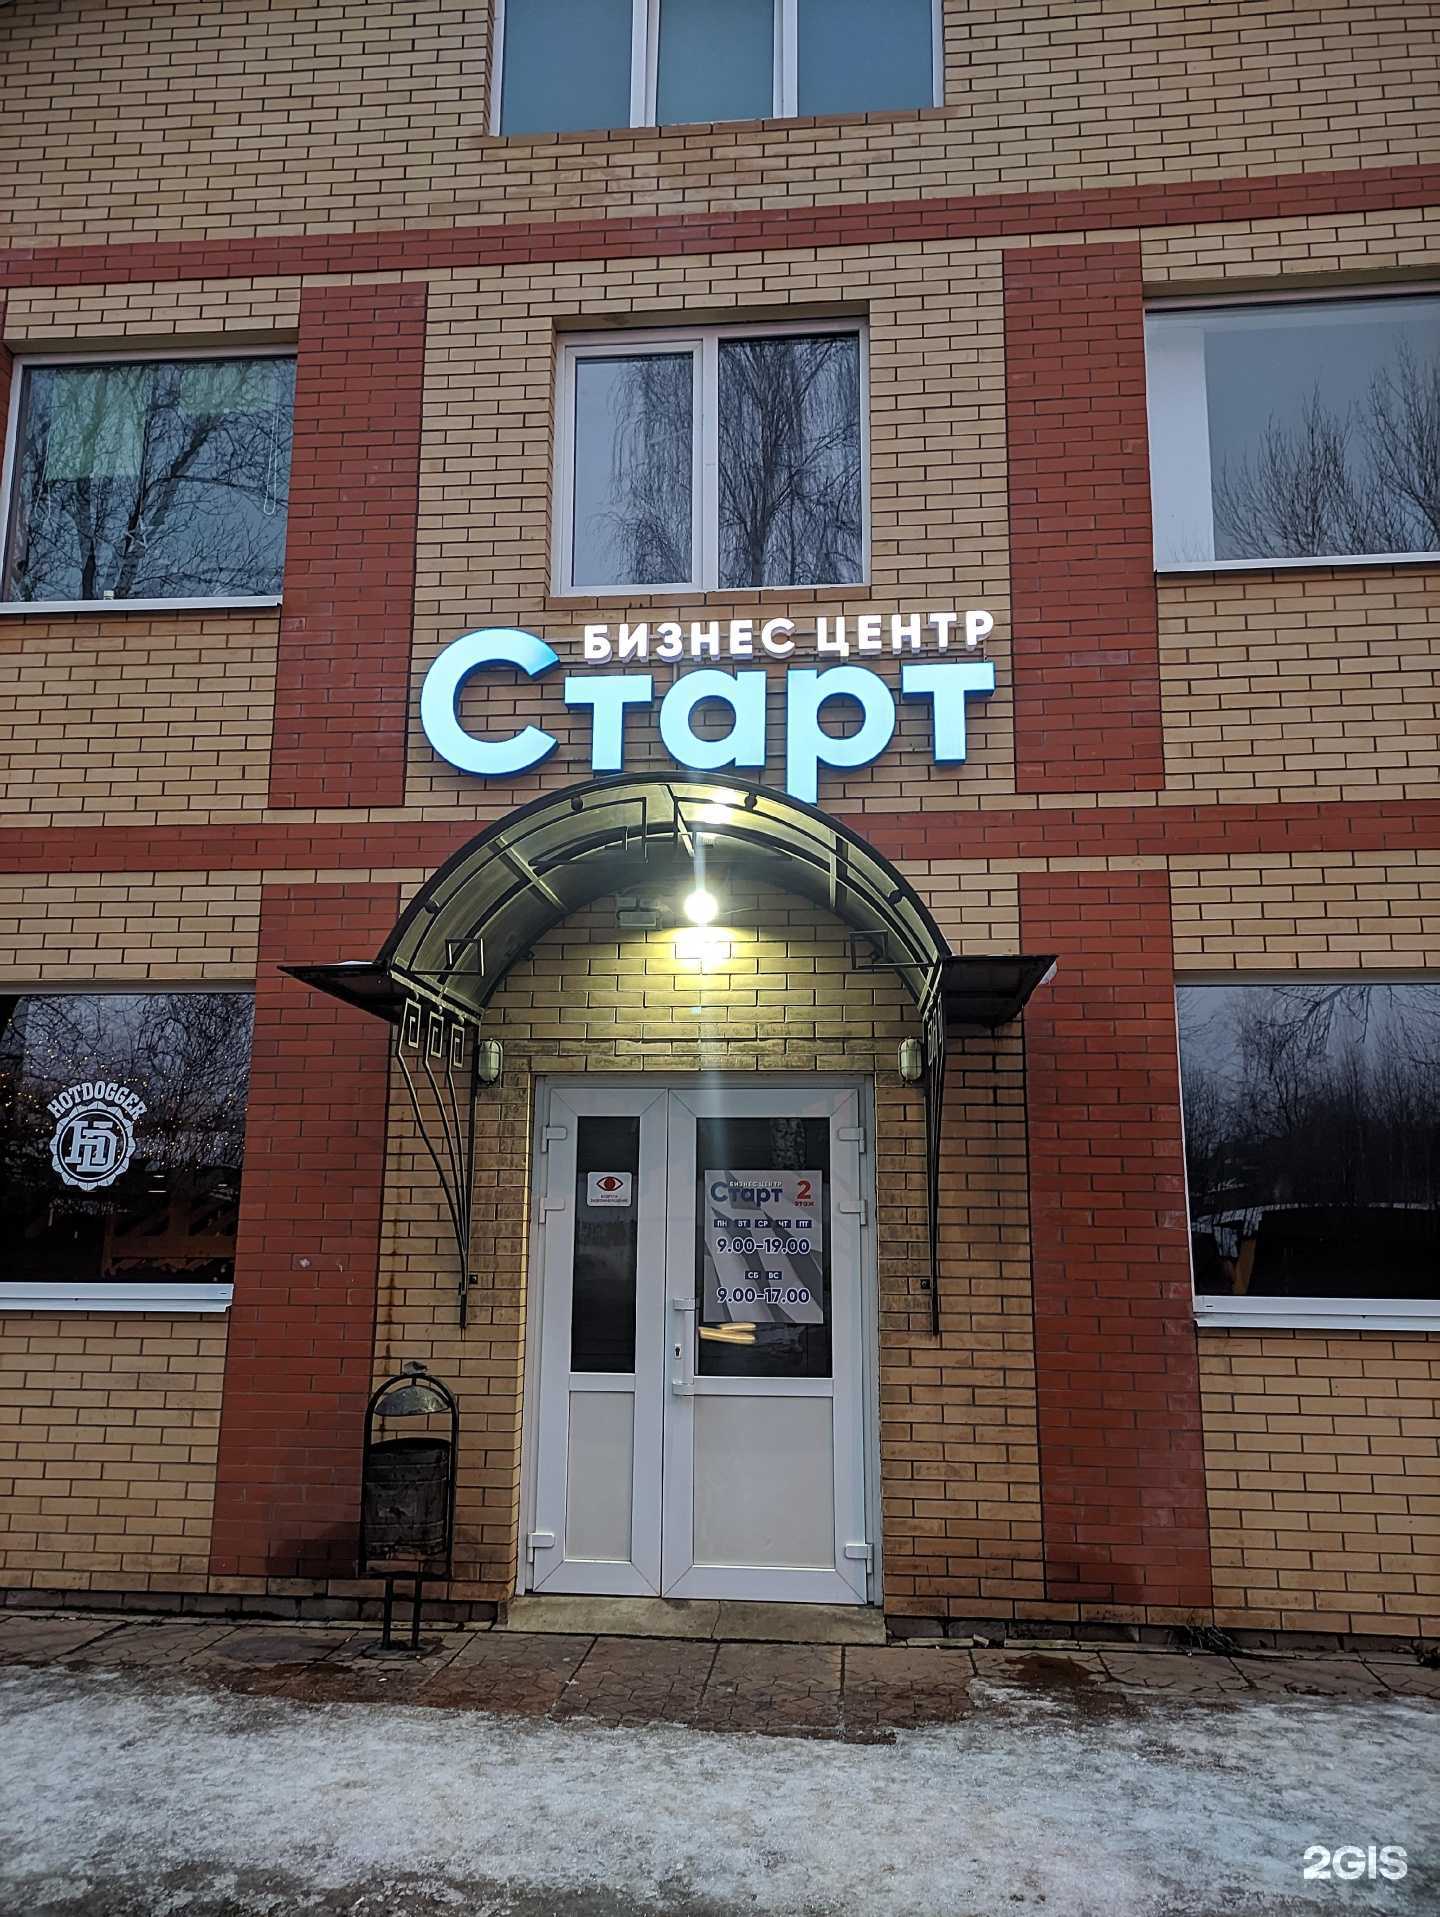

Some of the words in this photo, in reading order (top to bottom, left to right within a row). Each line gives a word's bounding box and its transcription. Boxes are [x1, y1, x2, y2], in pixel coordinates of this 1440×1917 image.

[583, 615, 796, 663] БИЗНЕС
[816, 609, 994, 657] ЦЕНТР
[419, 628, 995, 804] Старт
[46, 1080, 147, 1120] HOTDOGGER
[710, 1181, 784, 1207] Старт
[796, 1180, 811, 1200] 2
[717, 1238, 810, 1254] 9.00-19.00
[717, 1287, 810, 1304] 9.00-17.00
